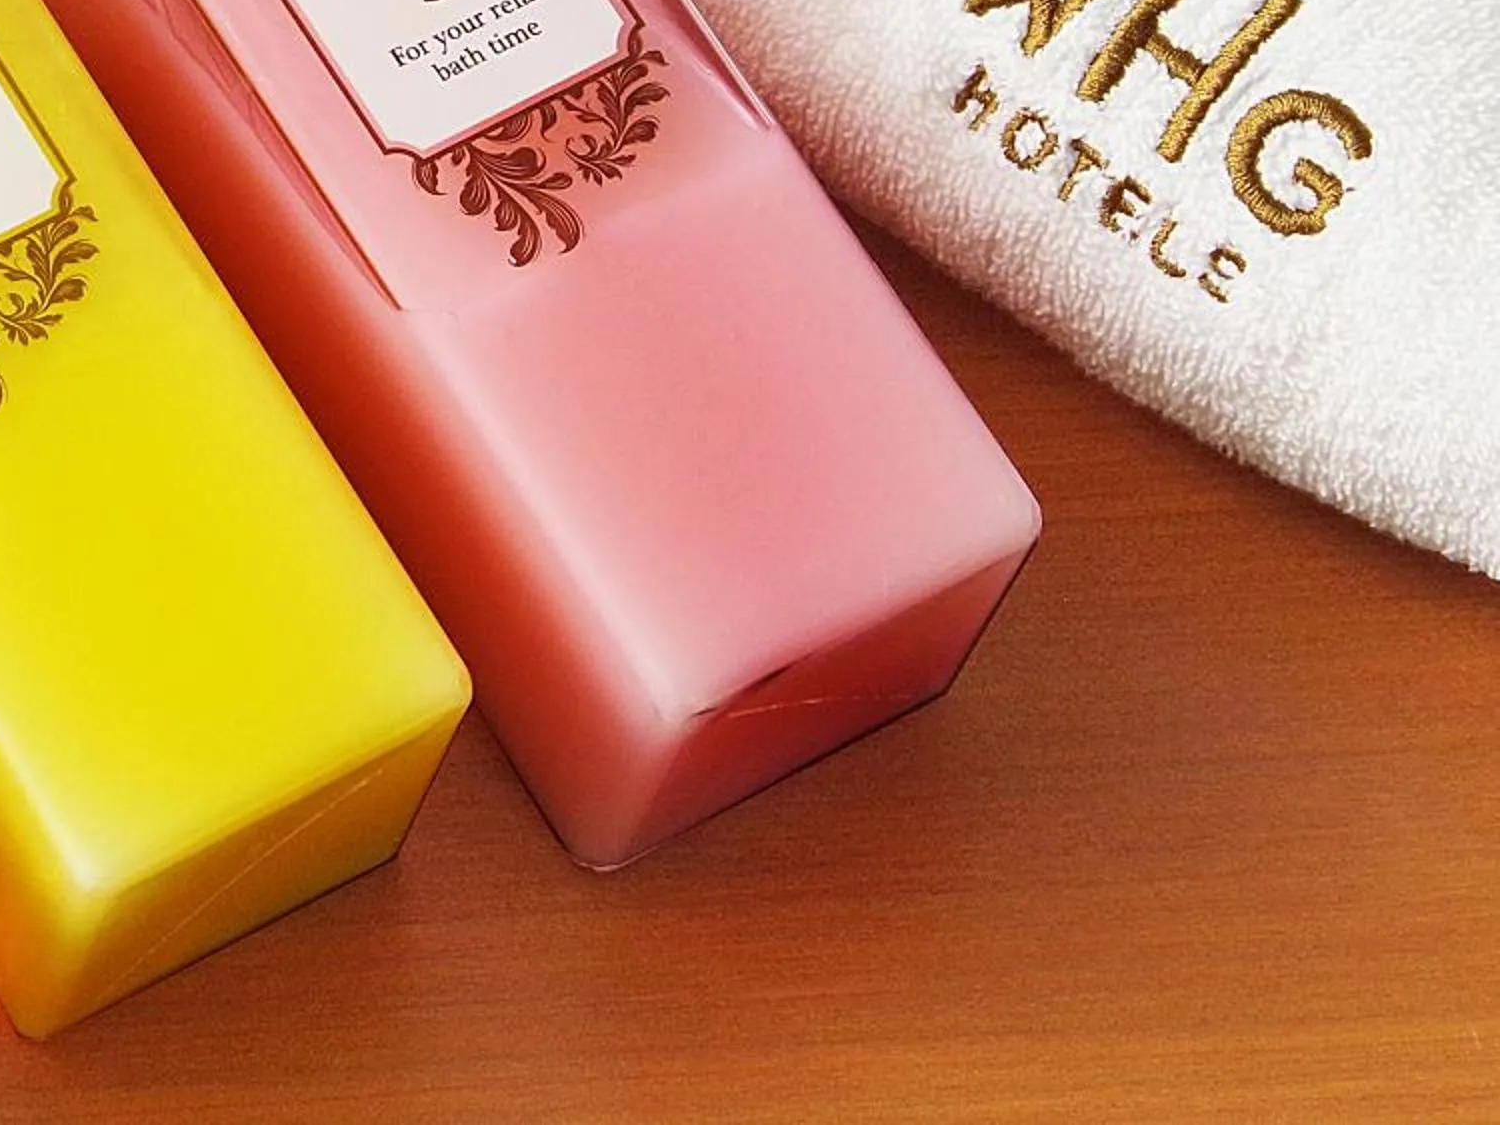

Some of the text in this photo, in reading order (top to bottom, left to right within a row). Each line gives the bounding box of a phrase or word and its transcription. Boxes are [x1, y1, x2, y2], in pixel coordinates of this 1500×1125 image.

[389, 38, 430, 68] For
[433, 10, 485, 54] your
[431, 17, 542, 82] bath time
